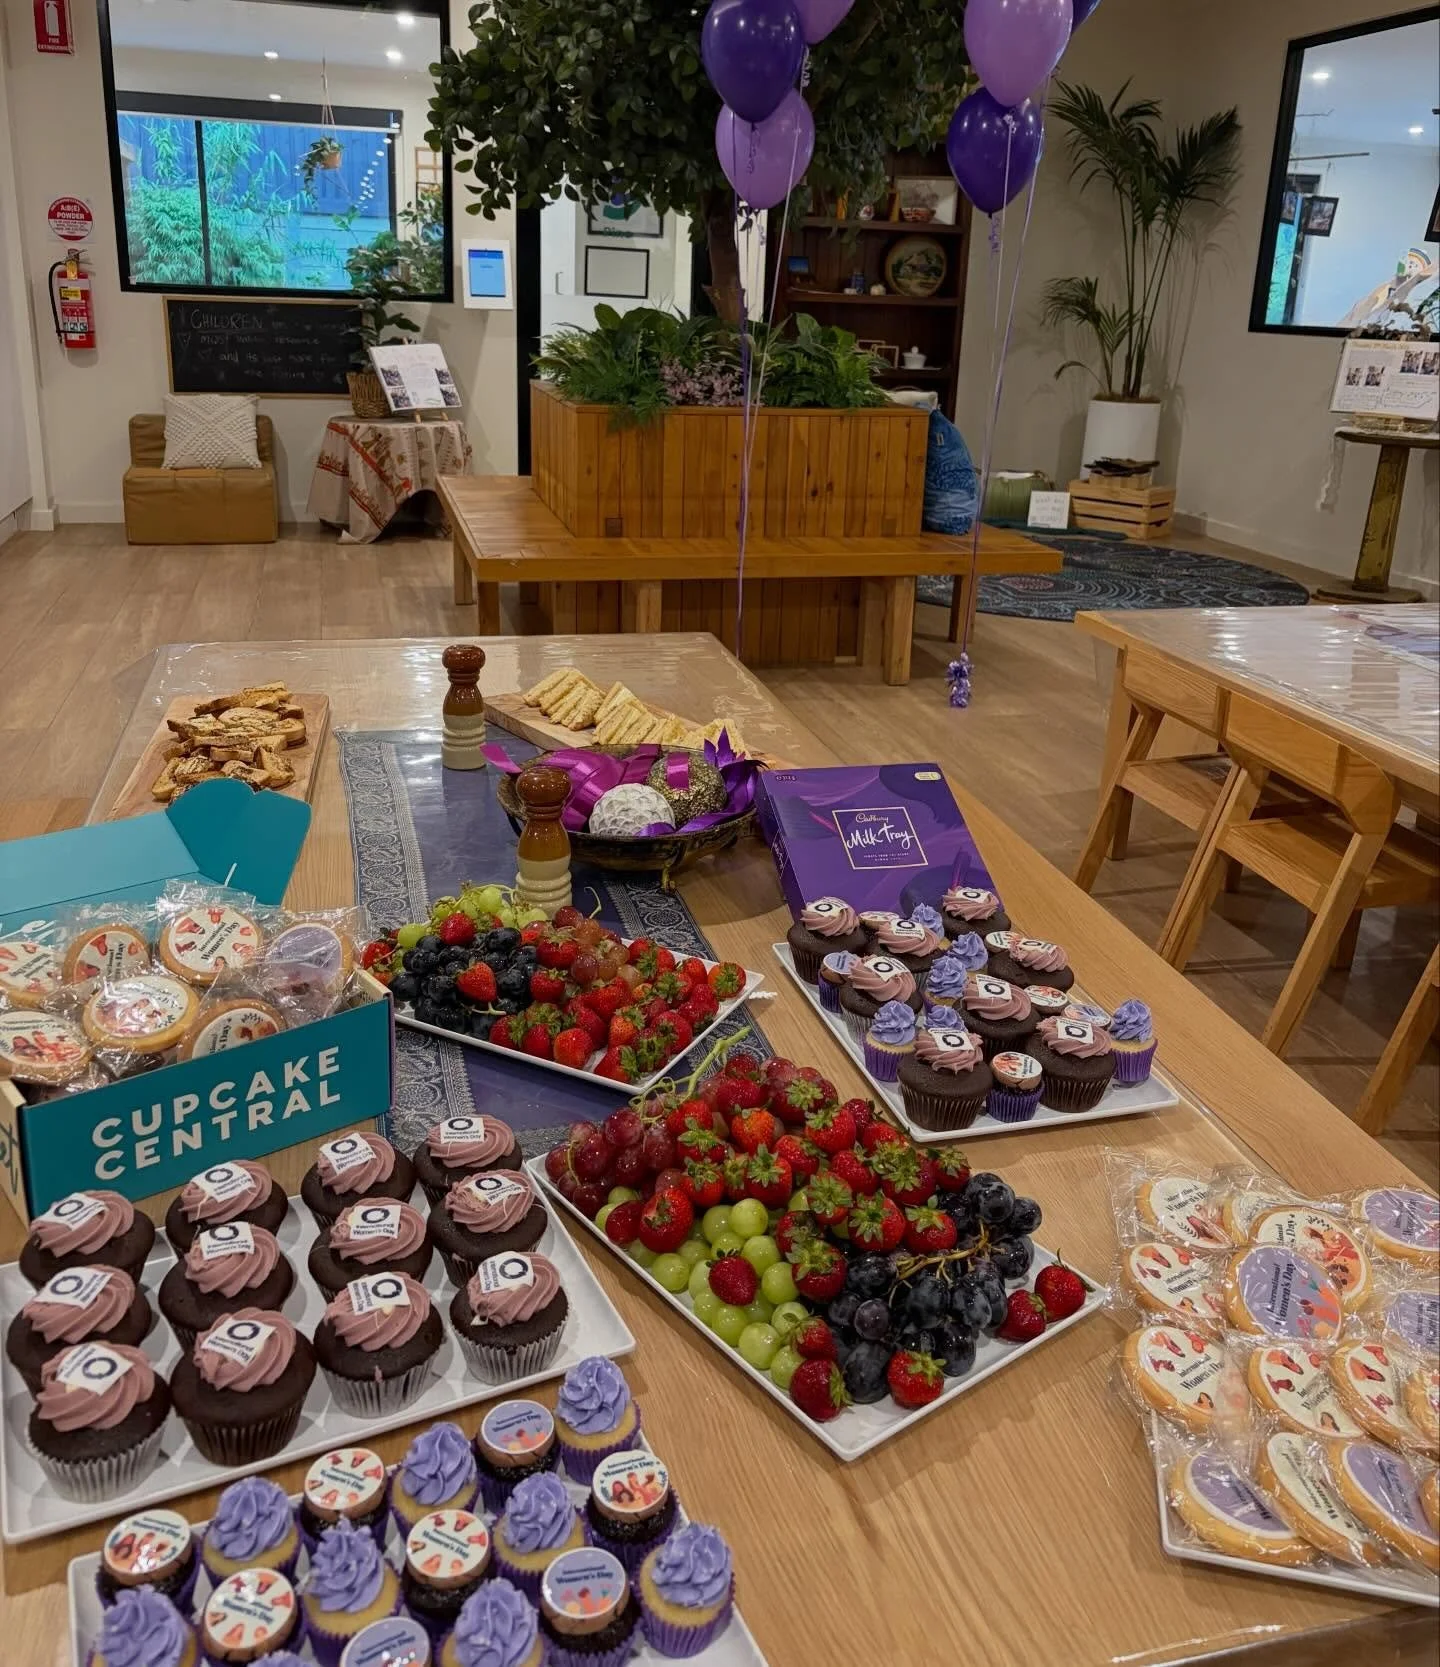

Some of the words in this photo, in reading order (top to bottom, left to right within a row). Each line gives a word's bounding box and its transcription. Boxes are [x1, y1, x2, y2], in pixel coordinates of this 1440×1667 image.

[56, 211, 85, 220] POWDER
[190, 308, 264, 329] CHILDREN
[855, 812, 889, 824] Cadbury
[847, 828, 883, 849] Milk
[877, 823, 914, 850] Tray
[226, 921, 240, 935] Day
[92, 1046, 340, 1148] CUPCAKE
[94, 1080, 341, 1180] CENTRAL
